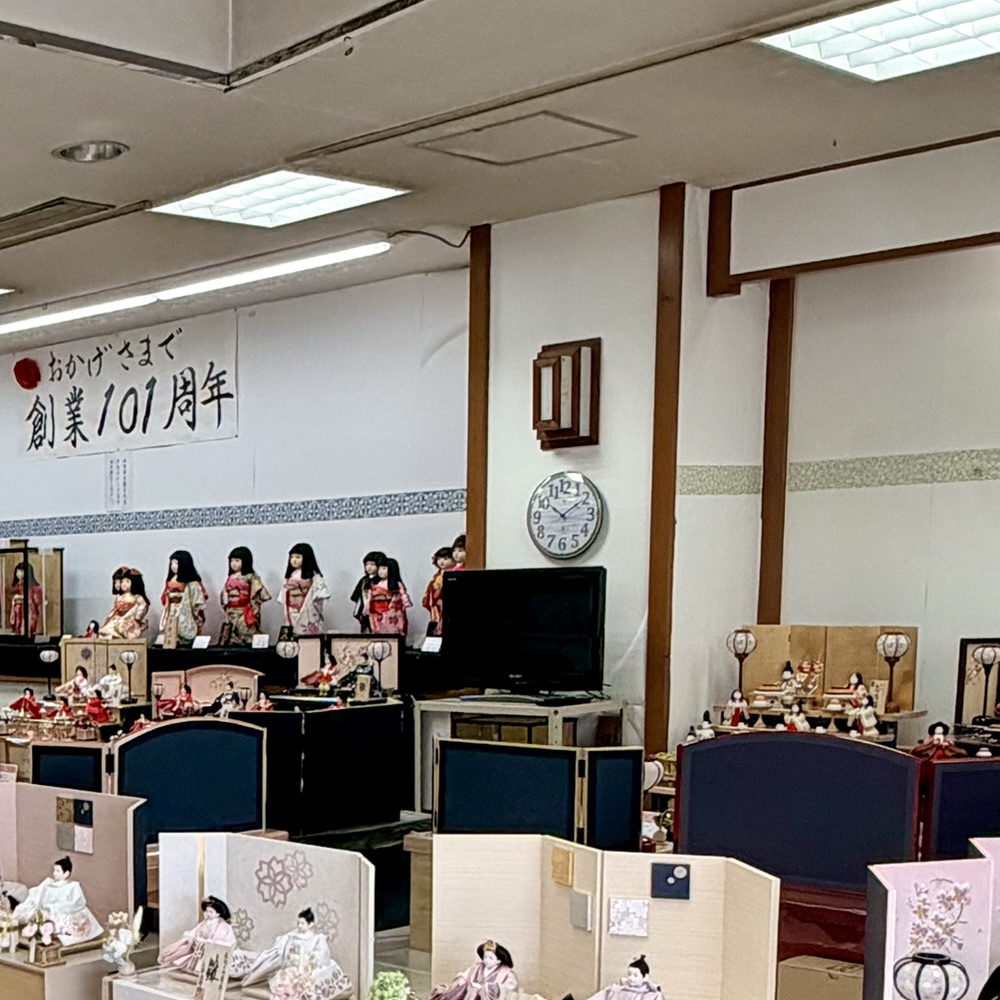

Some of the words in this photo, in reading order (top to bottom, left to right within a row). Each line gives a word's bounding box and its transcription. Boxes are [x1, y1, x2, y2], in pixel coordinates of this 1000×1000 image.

[48, 327, 182, 382] おかげさまで
[24, 361, 235, 451] 創業101周年
[549, 484, 559, 499] 11
[559, 479, 571, 494] 12
[574, 483, 581, 496] 1
[538, 496, 550, 509] 10
[582, 491, 590, 505] 2
[533, 511, 541, 524] 9
[586, 507, 595, 521] 3
[537, 525, 545, 539] 8
[580, 523, 589, 537] 4
[547, 534, 556, 548] 7
[558, 537, 567, 551] 6
[571, 534, 580, 548] 5
